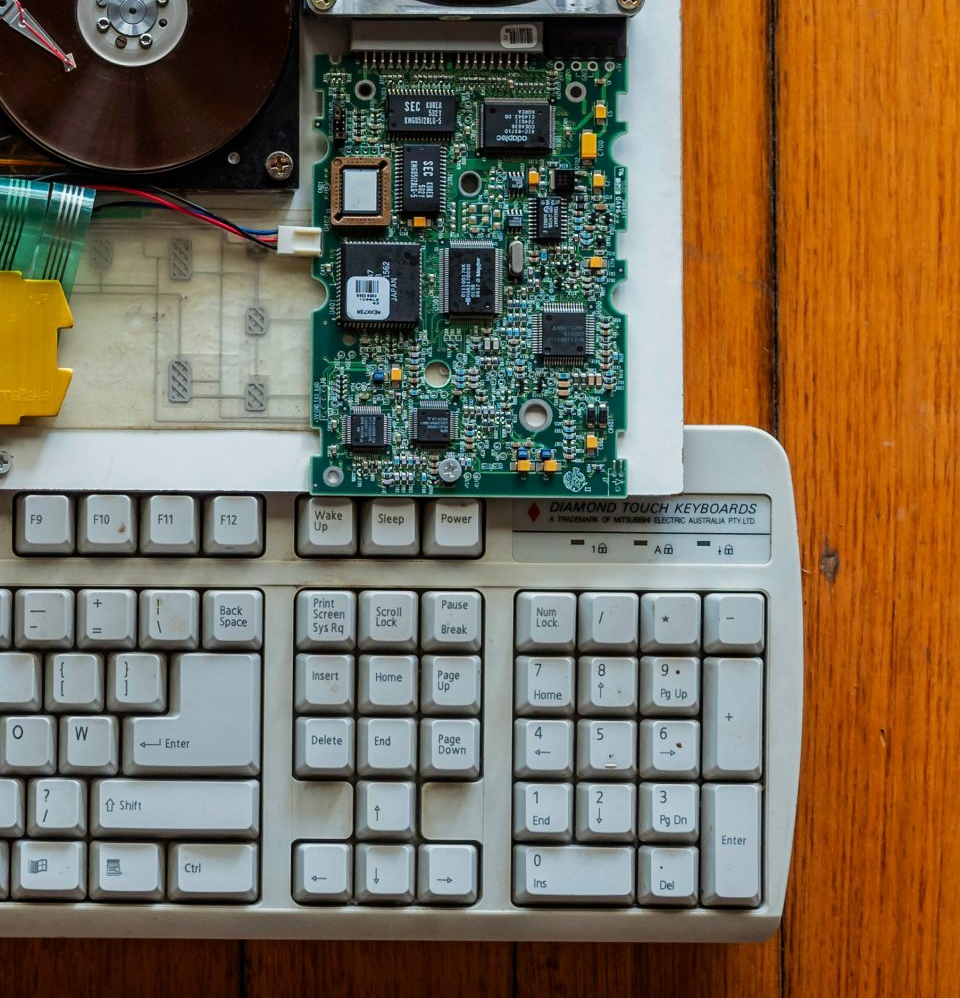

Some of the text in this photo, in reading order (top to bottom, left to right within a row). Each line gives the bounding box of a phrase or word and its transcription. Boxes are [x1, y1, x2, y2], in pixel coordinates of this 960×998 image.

[404, 101, 421, 112] SEC
[496, 134, 528, 143] adaptec
[423, 160, 433, 177] SEC
[390, 277, 398, 302] JAPAN
[549, 502, 757, 514] DIAMOND TOUCH KEYBOARDS
[31, 515, 42, 524] F9
[94, 515, 109, 524] F10
[158, 514, 173, 524] F11
[221, 515, 237, 525] F12
[315, 511, 342, 521] Wake
[378, 514, 404, 525] Sleep
[441, 514, 472, 523] Power
[315, 522, 328, 533] Up
[654, 546, 662, 554] A
[313, 599, 334, 609] Print
[442, 600, 468, 609] Pause
[220, 606, 243, 616] Back
[313, 609, 345, 619] Screen
[376, 607, 401, 617] Scroll
[537, 608, 556, 617] Num
[220, 617, 247, 629] Space
[376, 618, 397, 627] Lock
[537, 618, 557, 627] Lock
[313, 623, 343, 635] Sys Rq
[442, 625, 467, 634] Break
[535, 663, 542, 676] 7
[598, 664, 605, 676] 8
[662, 664, 668, 676] 9
[313, 671, 338, 680] Insert
[376, 673, 402, 682] Home
[438, 671, 460, 683] Page
[438, 681, 450, 693] Up
[534, 690, 562, 700] Home
[661, 689, 687, 700] Pg Up
[13, 725, 23, 739] O
[76, 727, 88, 740] W
[535, 726, 542, 738] 4
[597, 728, 603, 740] 5
[660, 727, 667, 739] 6
[166, 739, 189, 748] Enter
[312, 735, 342, 745] Delete
[375, 736, 390, 746] End
[438, 735, 460, 747] Page
[438, 746, 466, 755] Down
[533, 791, 538, 804] 1
[597, 791, 603, 803] 2
[660, 791, 667, 803] 3
[120, 800, 141, 810] Shift
[533, 816, 550, 825] End
[660, 815, 687, 827] Pg Dn
[722, 835, 746, 845] Enter
[534, 854, 541, 866] 0
[185, 863, 201, 873] Ctrl
[534, 879, 546, 888] Ins
[660, 881, 674, 890] Del
